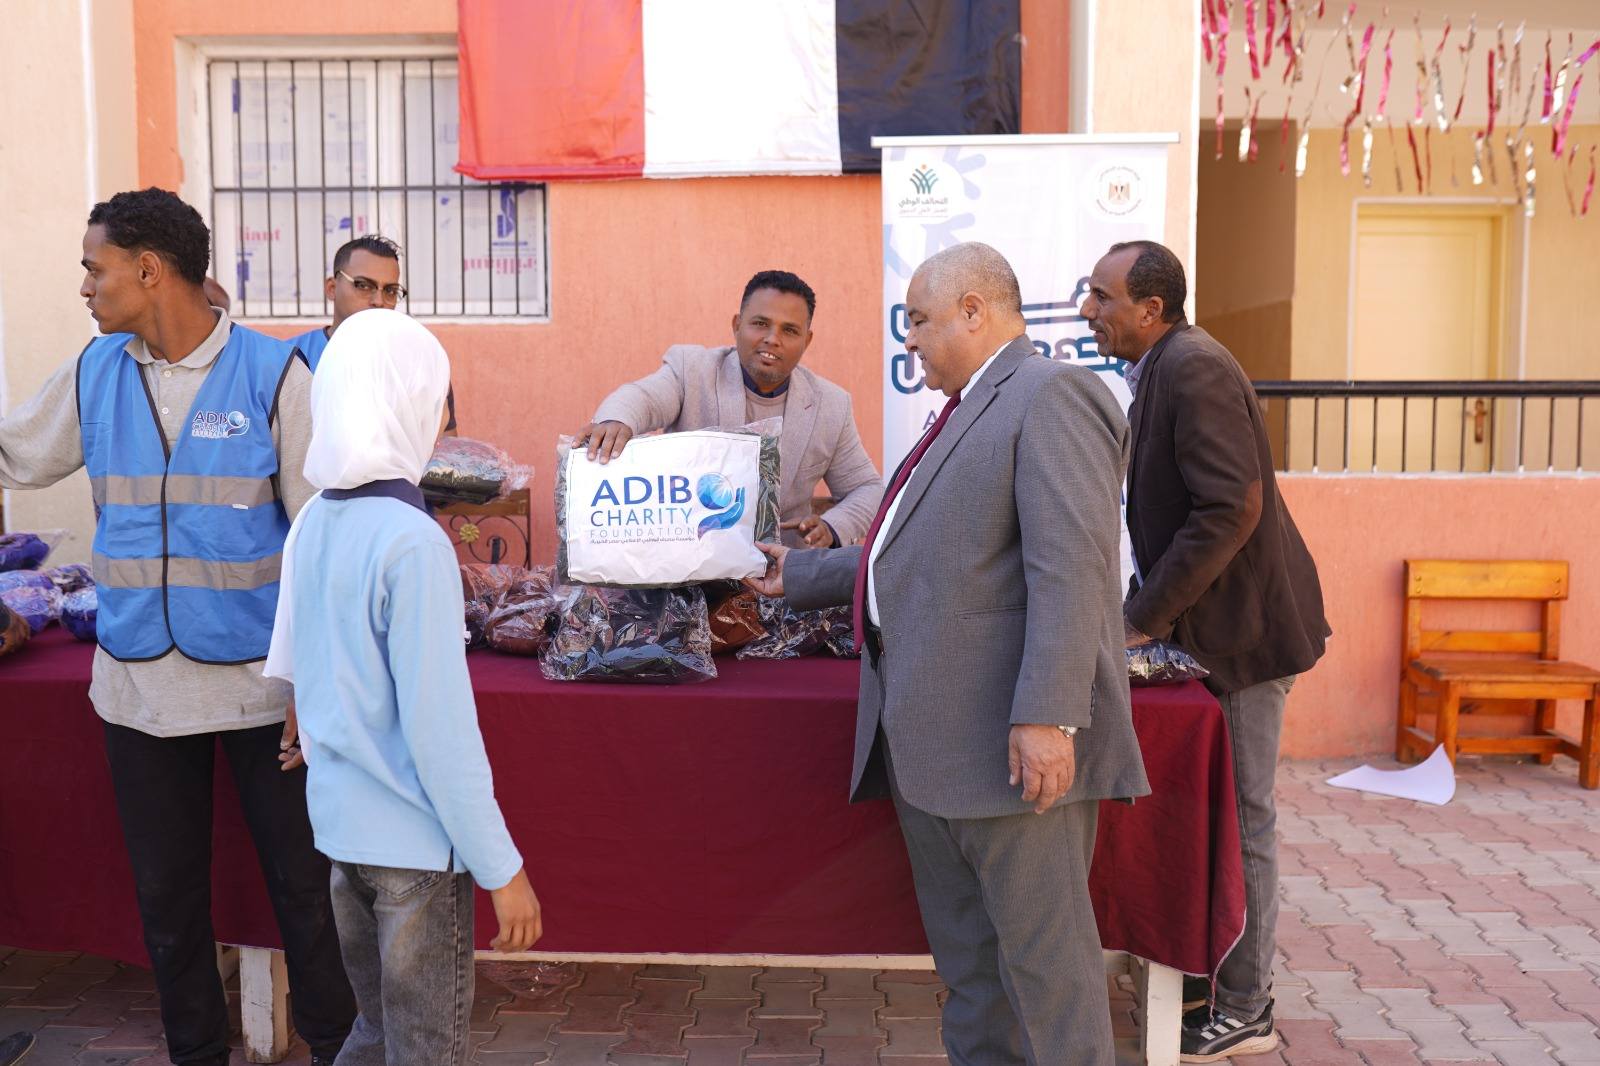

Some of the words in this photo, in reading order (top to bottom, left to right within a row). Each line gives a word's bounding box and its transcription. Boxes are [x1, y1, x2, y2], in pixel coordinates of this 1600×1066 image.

[590, 475, 692, 507] ADIB
[590, 507, 693, 527] CHARITY
[590, 526, 696, 538] FOUNDATION
